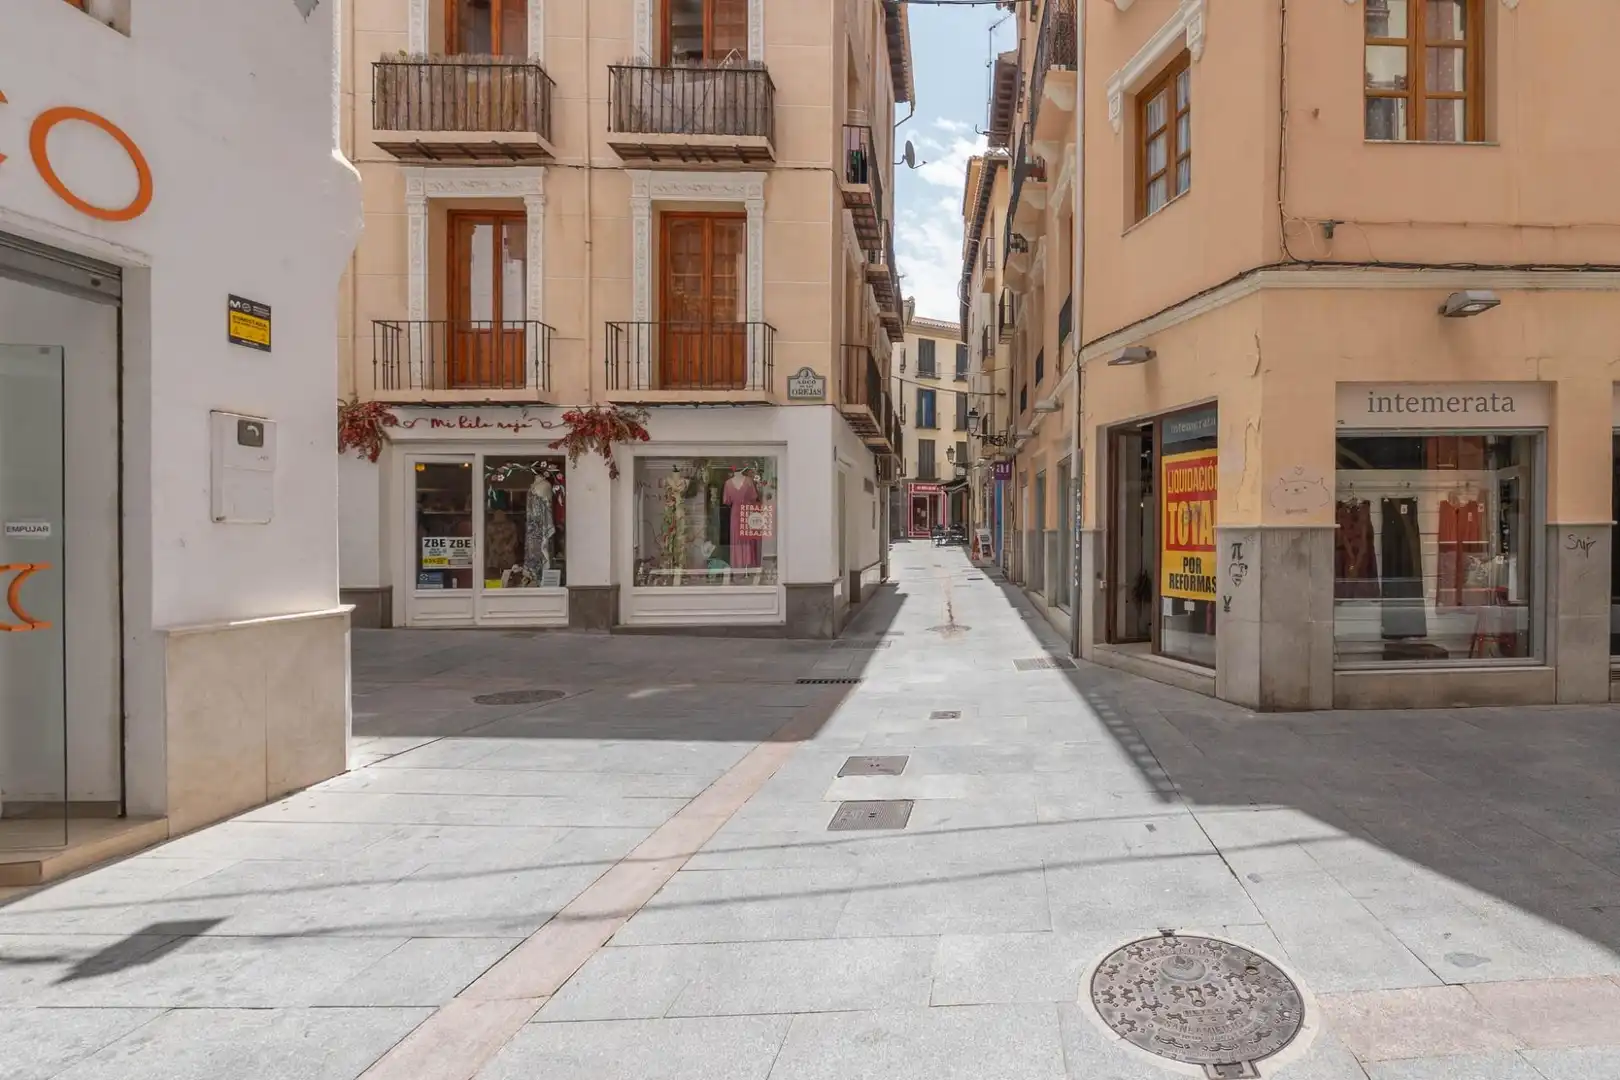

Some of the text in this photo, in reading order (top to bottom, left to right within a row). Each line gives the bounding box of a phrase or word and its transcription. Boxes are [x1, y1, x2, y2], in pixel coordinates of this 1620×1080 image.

[1368, 391, 1516, 413] intemerata
[430, 418, 455, 428] Mi
[424, 539, 446, 548] ZBE
[449, 540, 472, 548] ZBE
[1183, 556, 1202, 574] POR
[1169, 573, 1216, 594] REFORMAS
